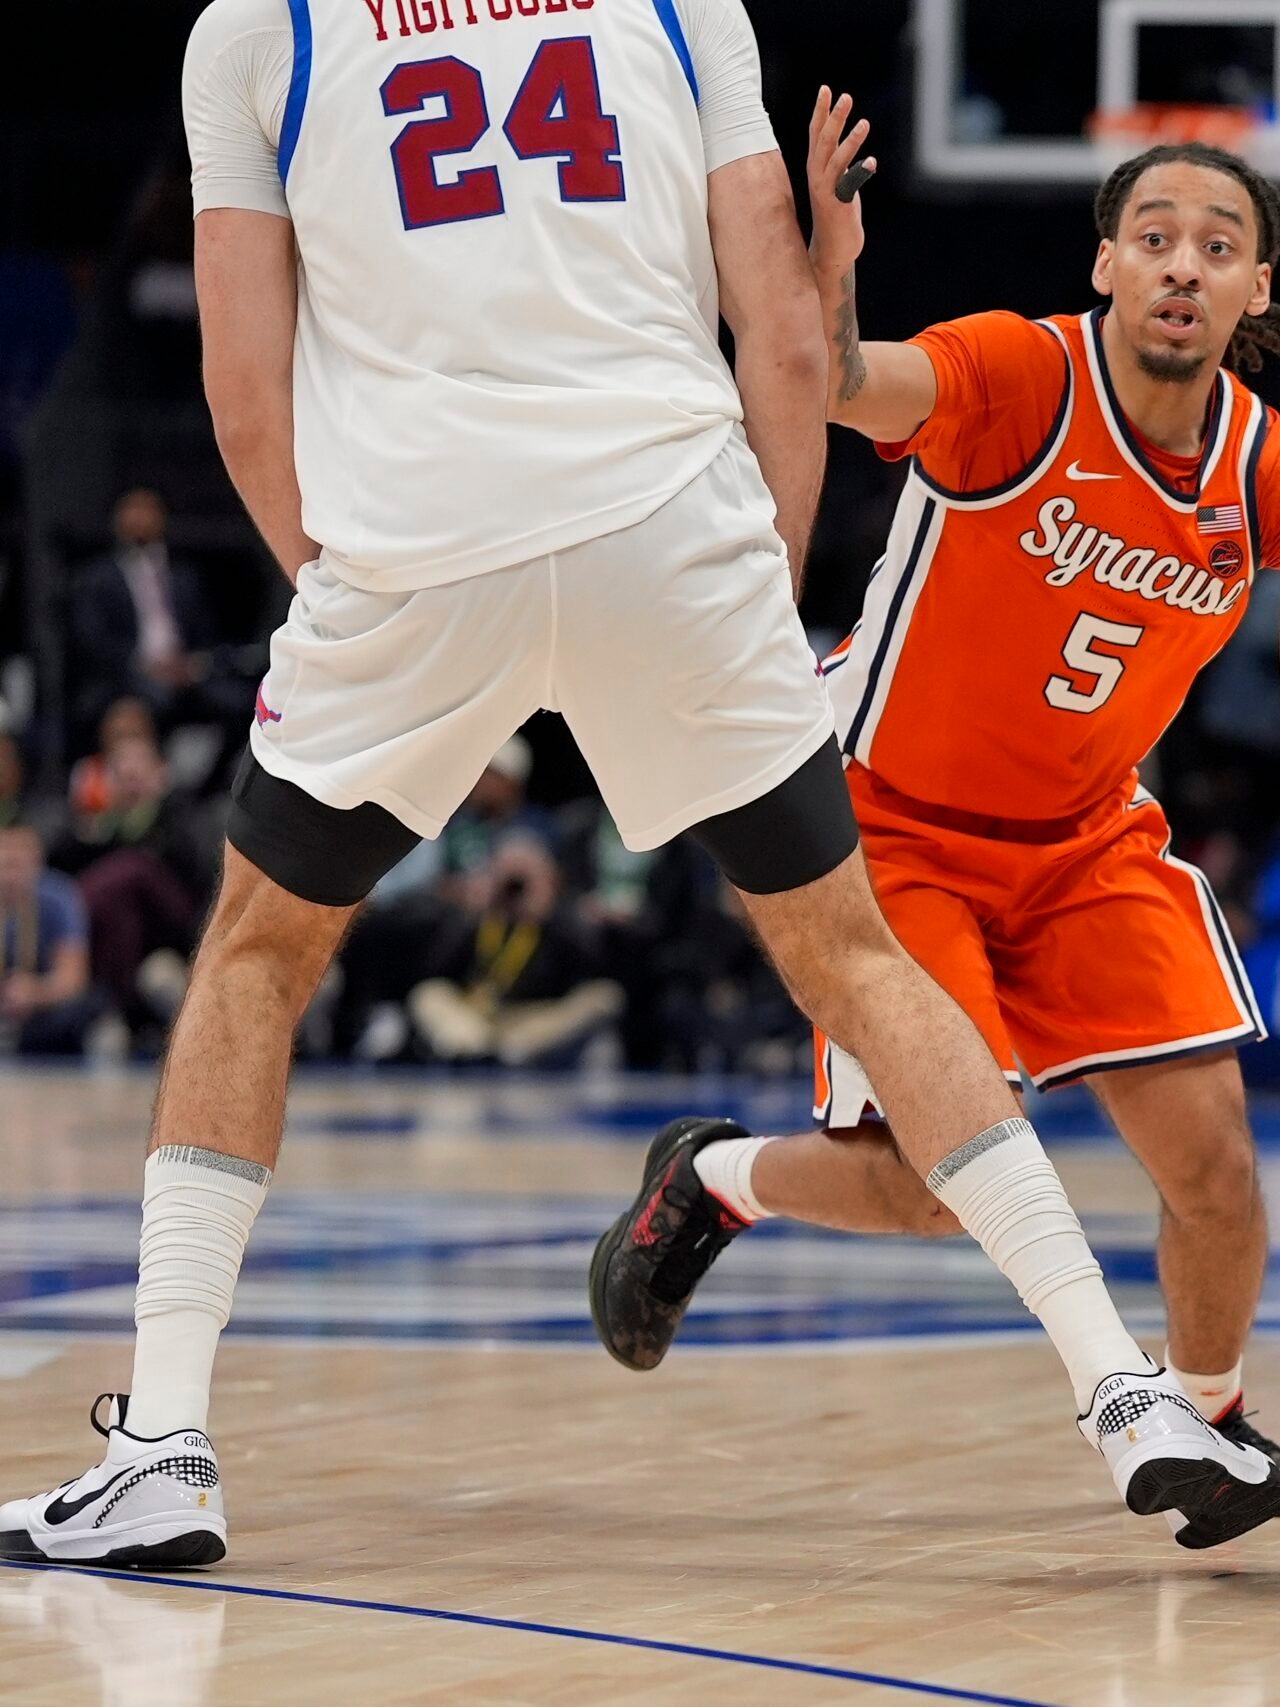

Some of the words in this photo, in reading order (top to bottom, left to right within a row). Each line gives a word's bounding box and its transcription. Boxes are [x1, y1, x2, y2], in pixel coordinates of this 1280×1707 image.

[379, 36, 626, 231] 24
[1018, 496, 1246, 616] Syracuse
[1042, 610, 1145, 714] 5
[1098, 1377, 1125, 1400] GIGI
[184, 1435, 209, 1450] GIGI
